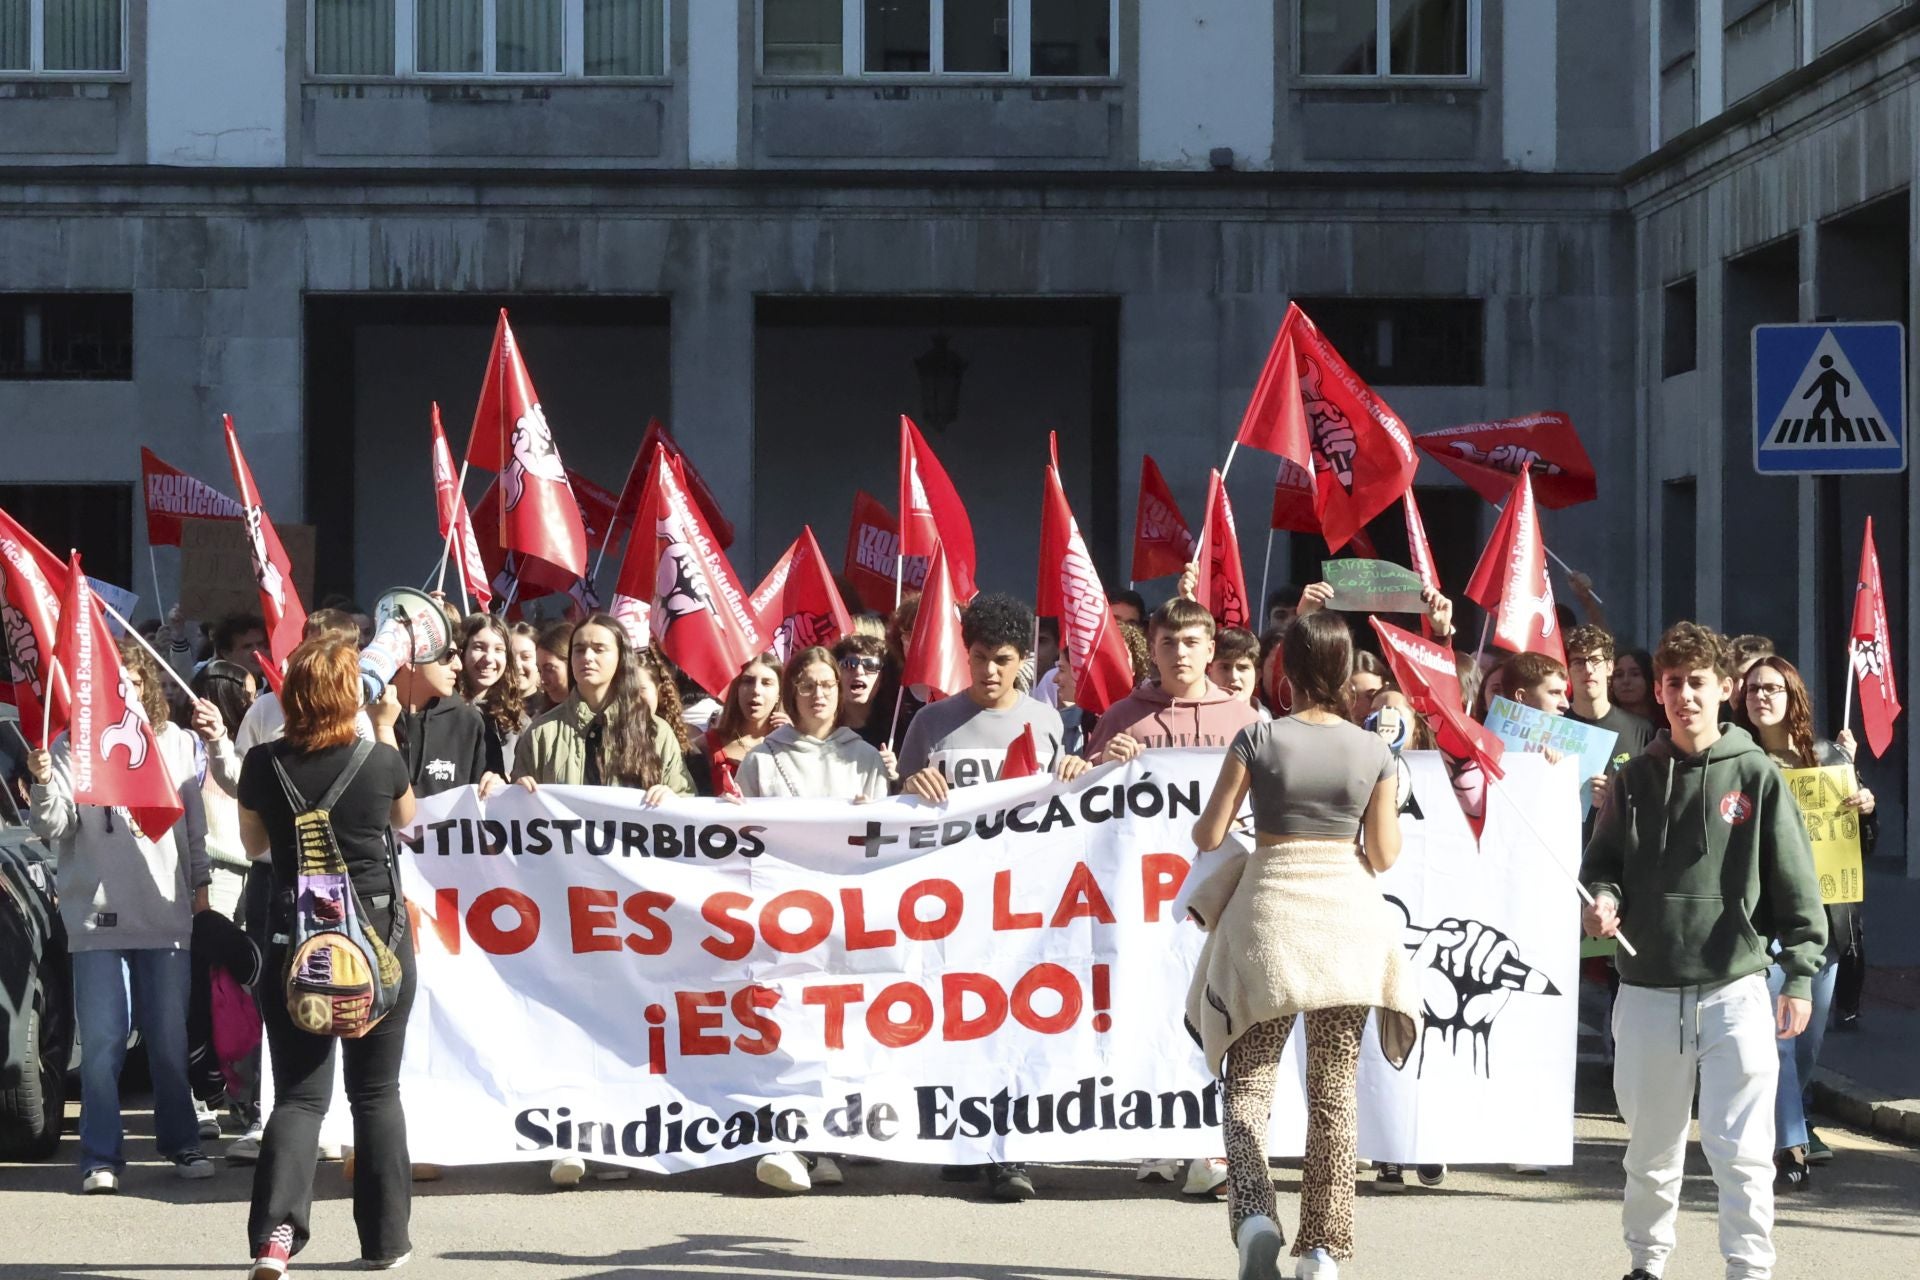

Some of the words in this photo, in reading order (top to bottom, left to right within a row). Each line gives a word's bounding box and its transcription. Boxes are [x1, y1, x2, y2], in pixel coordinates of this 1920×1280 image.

[76, 574, 92, 681] Estudiantes
[706, 551, 760, 645] Estudiantes
[78, 682, 92, 706] de
[77, 706, 93, 794] Sindicato
[908, 772, 1200, 849] EDUCACIÓN
[405, 886, 541, 956] NO
[568, 885, 676, 956] ES
[699, 878, 964, 962] SOLO
[992, 861, 1117, 931] LA
[643, 984, 783, 1075] ¡ES
[802, 962, 1113, 1050] TODO!
[514, 1101, 809, 1158] Sindicato
[822, 1092, 900, 1143] de
